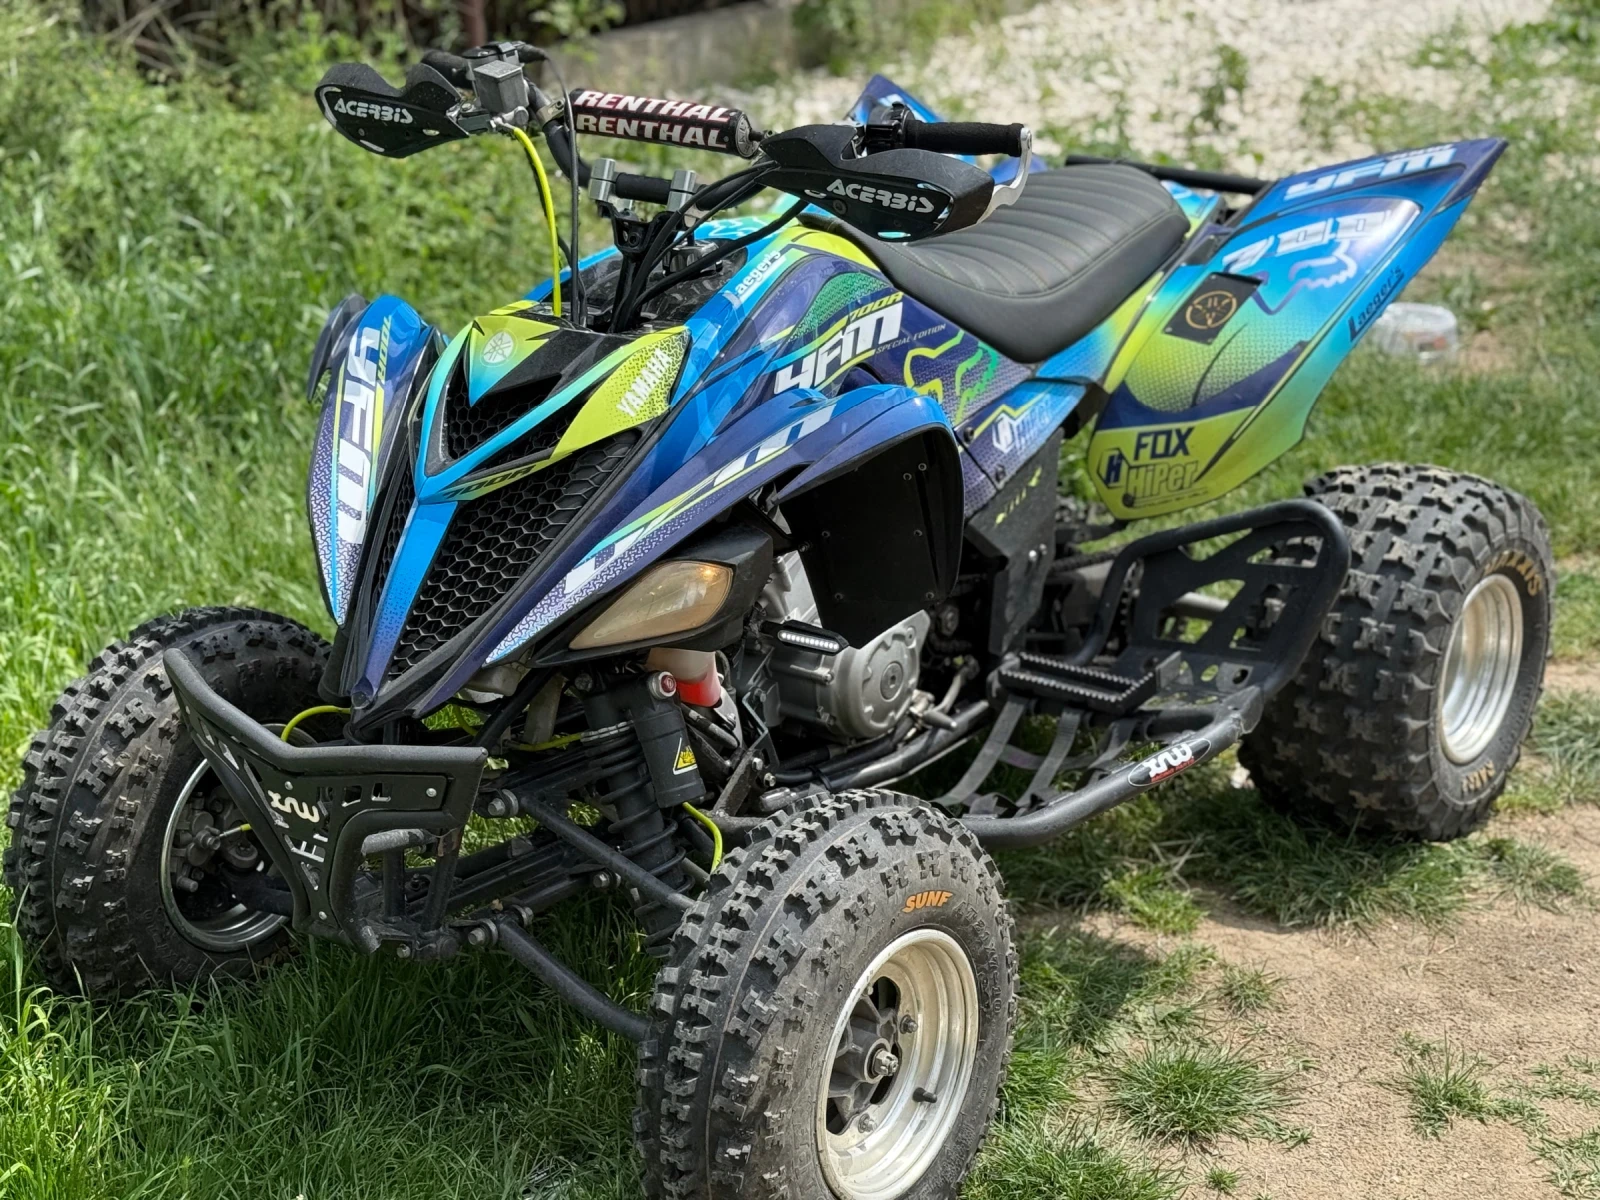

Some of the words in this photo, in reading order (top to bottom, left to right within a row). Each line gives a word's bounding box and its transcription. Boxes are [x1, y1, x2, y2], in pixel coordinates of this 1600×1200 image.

[573, 90, 733, 122] RENTHAL
[575, 114, 729, 149] RENTHAL
[1284, 148, 1457, 200] YFM
[850, 291, 904, 321] 700R
[774, 302, 904, 395] YFM
[876, 335, 911, 355] SPECIAL
[913, 324, 946, 341] EDITION
[616, 347, 672, 418] YAMAHA
[335, 326, 380, 546] YFM
[1134, 427, 1195, 461] FOX
[902, 890, 953, 913] SUNF
